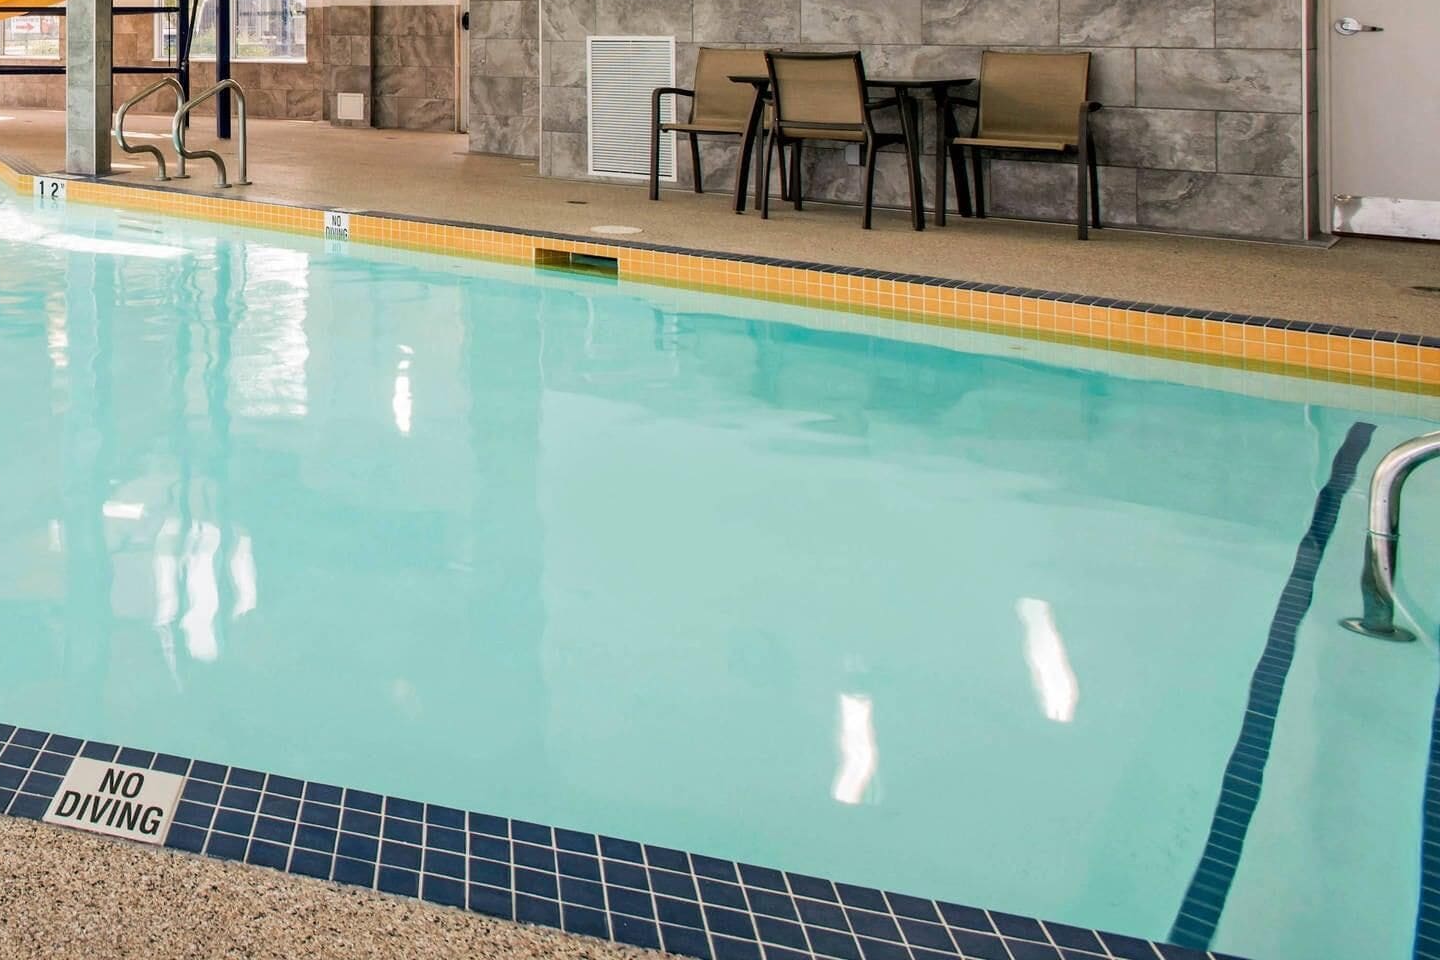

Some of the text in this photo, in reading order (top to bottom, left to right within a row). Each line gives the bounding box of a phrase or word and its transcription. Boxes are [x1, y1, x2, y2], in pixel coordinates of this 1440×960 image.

[332, 215, 341, 227] NO
[325, 226, 348, 240] DIVING
[98, 768, 145, 799] NO
[54, 790, 164, 836] DIVING
